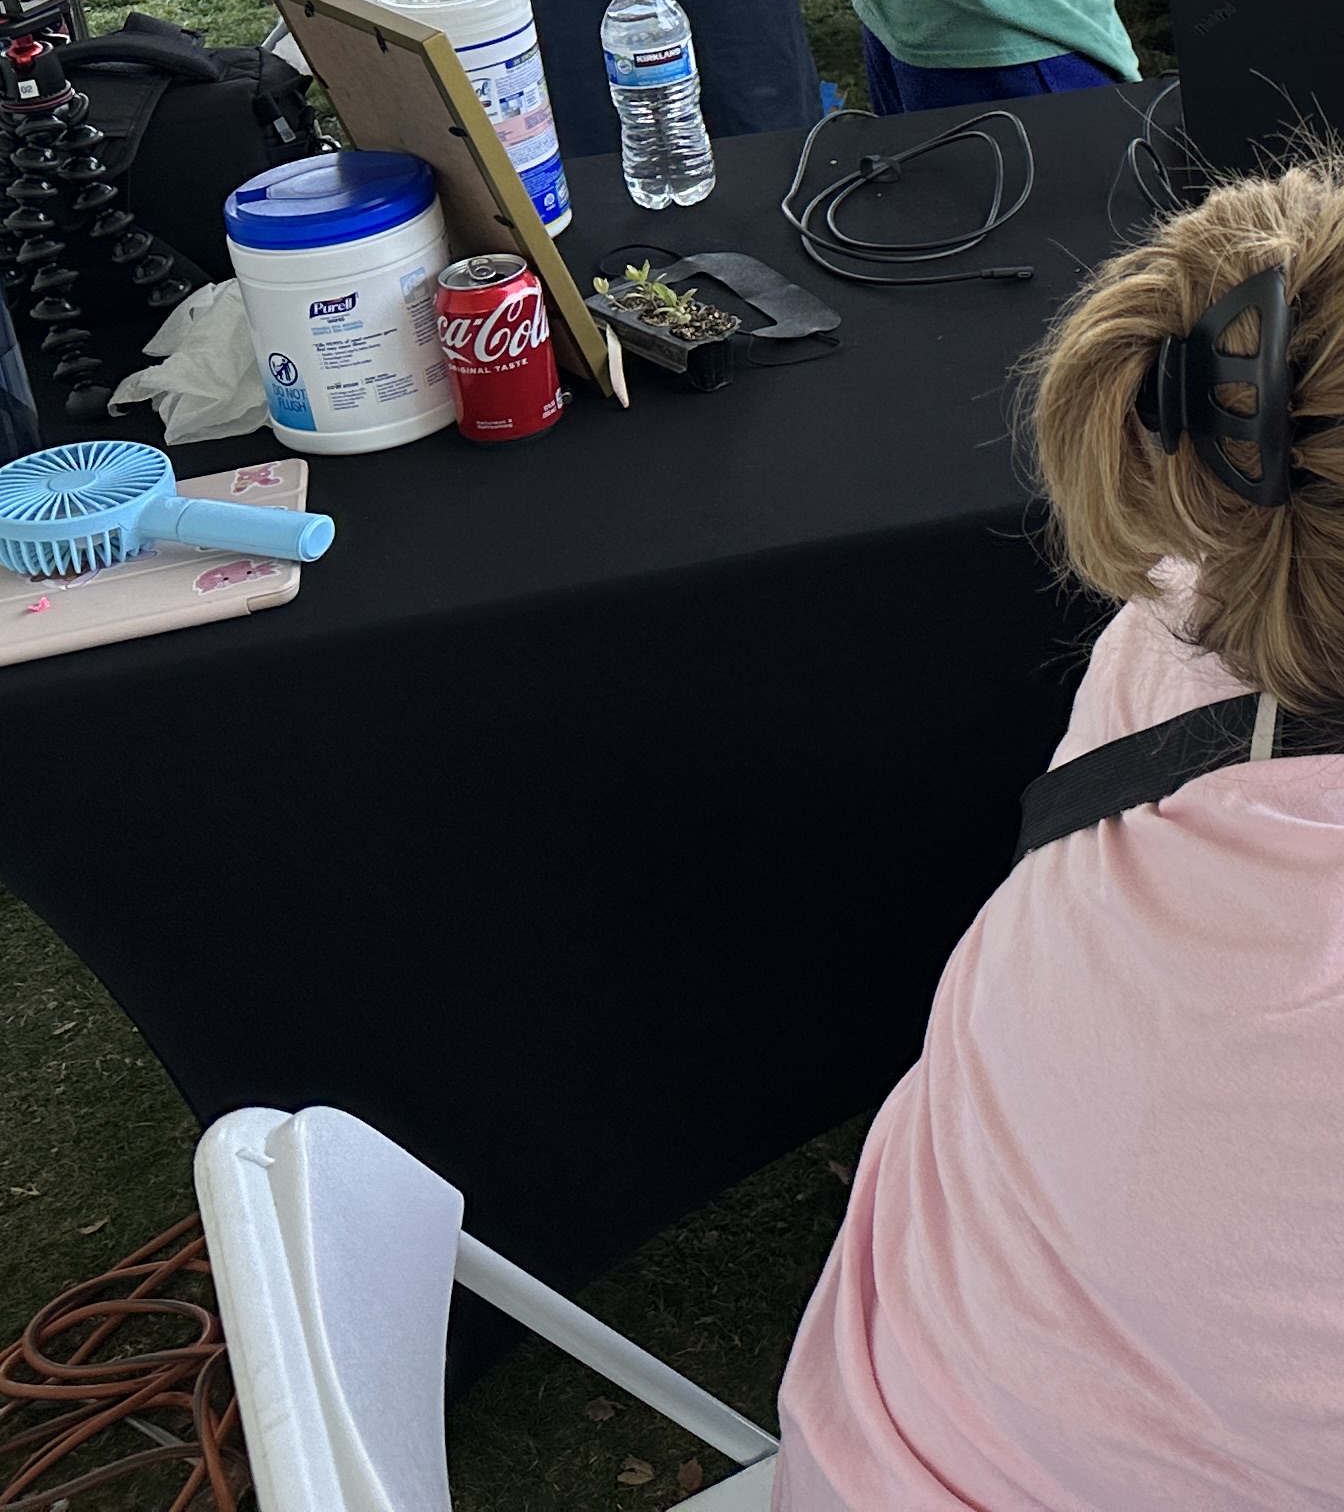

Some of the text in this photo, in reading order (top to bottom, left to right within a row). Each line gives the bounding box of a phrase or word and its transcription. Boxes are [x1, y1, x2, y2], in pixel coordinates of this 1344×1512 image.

[636, 47, 681, 63] KIRKLAND
[313, 297, 353, 315] Purell
[494, 357, 529, 374] TASTE
[272, 382, 307, 402] DO NOT
[278, 396, 308, 414] FLUSH
